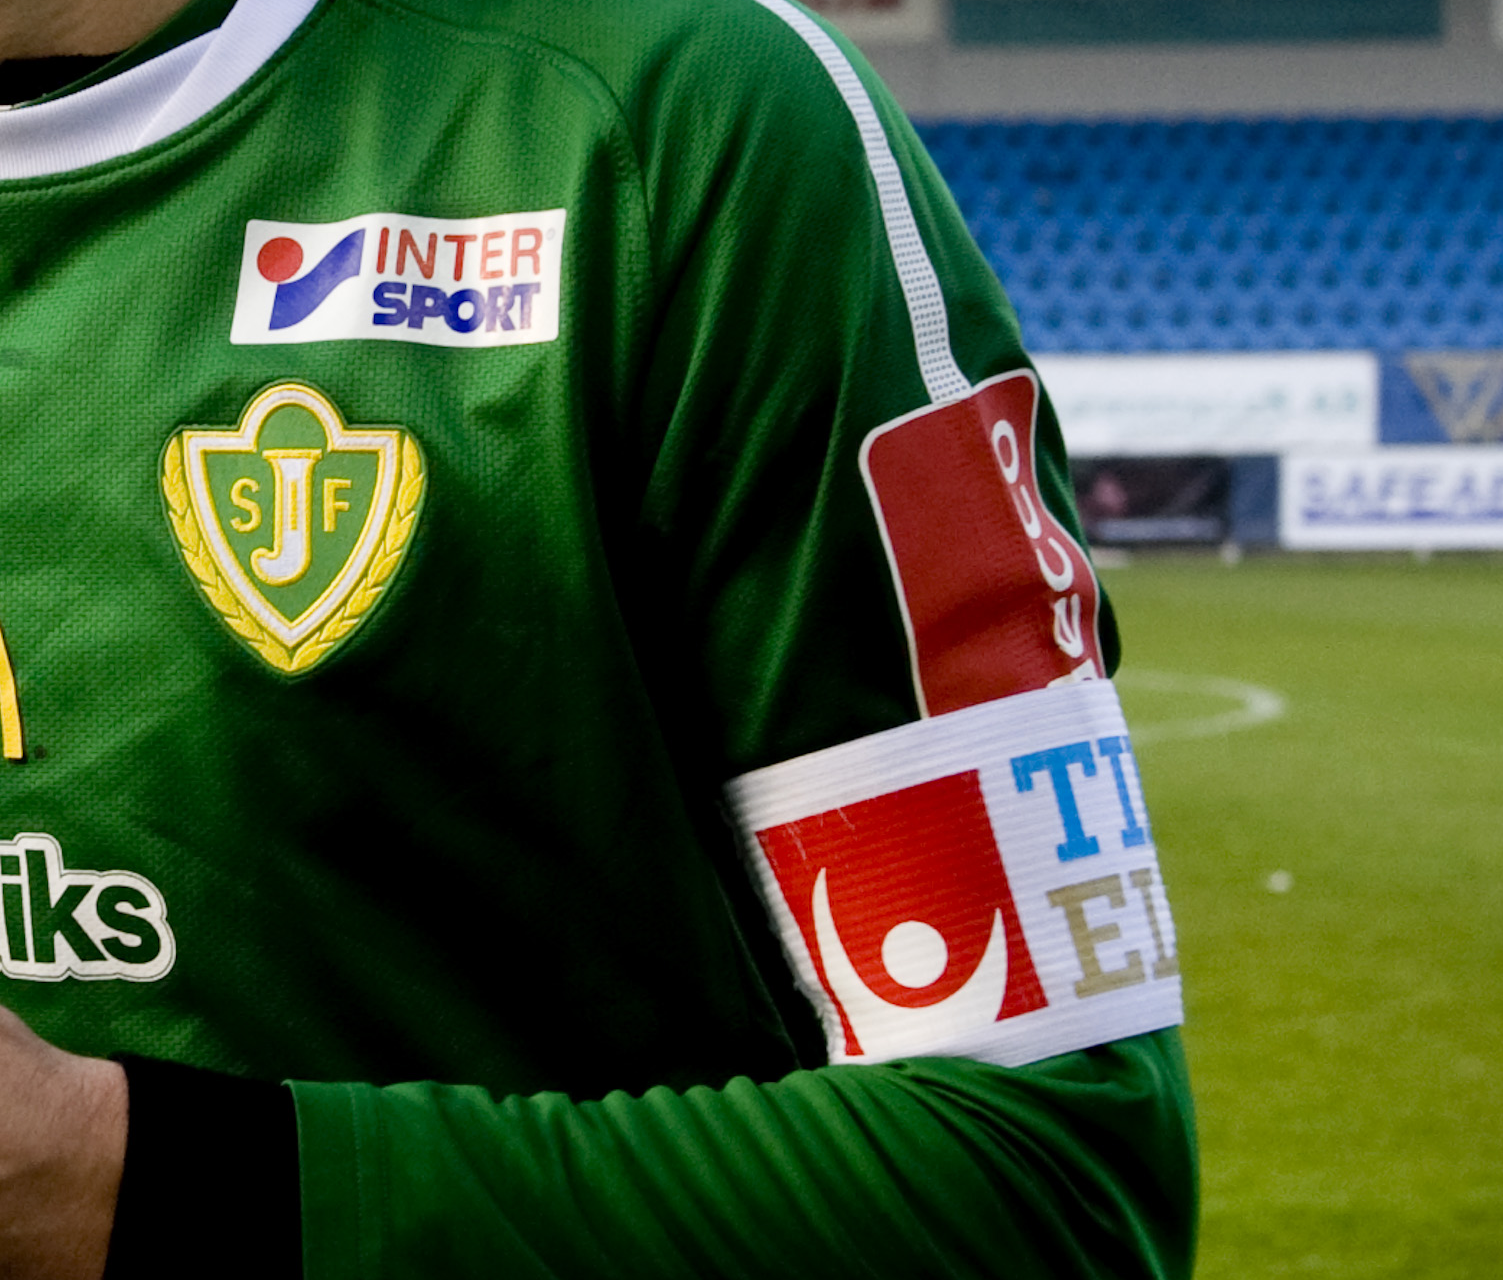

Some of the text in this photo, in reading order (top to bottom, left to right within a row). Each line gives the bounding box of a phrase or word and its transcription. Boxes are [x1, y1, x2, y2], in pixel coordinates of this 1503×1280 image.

[375, 225, 545, 282] INTER
[371, 281, 542, 334] SPORT
[1010, 735, 1152, 862] TI
